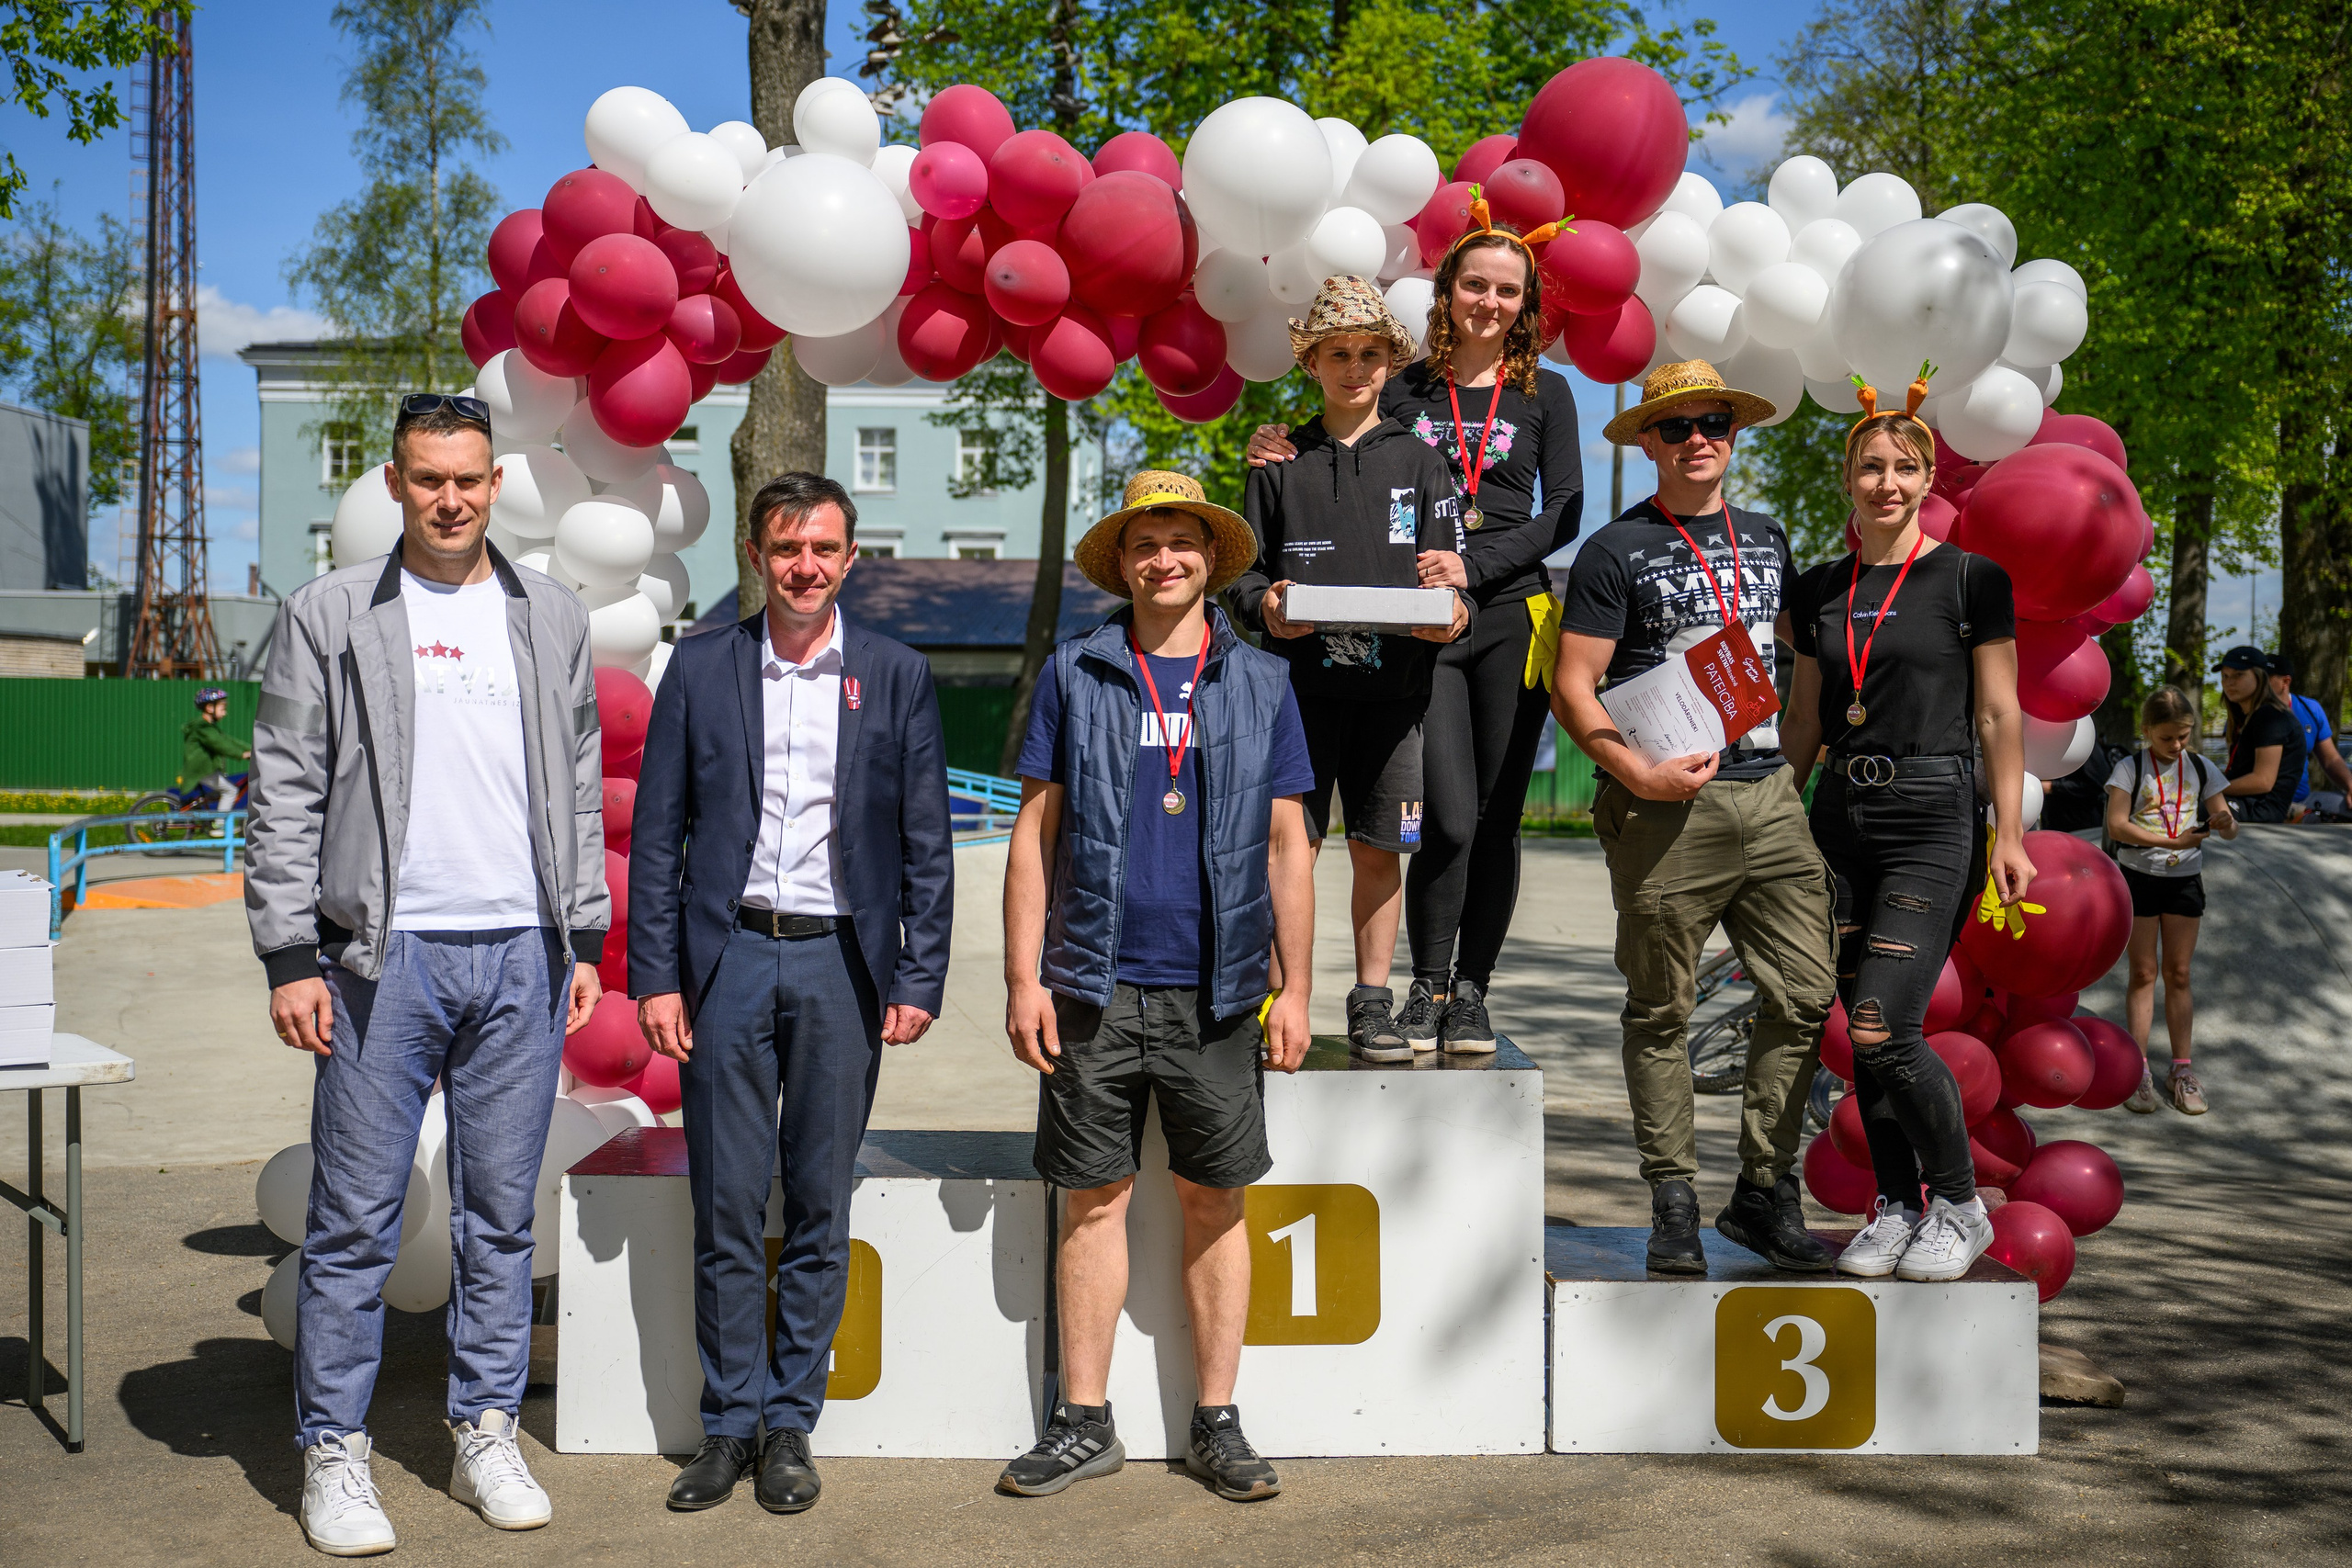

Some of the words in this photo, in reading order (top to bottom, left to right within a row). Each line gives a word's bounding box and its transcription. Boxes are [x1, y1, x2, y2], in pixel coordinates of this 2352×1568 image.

[1674, 691, 1699, 733] VELODĀRZNIEKI
[1704, 662, 1738, 721] PATEICĪBA
[1267, 1213, 1317, 1317] 1
[1761, 1314, 1831, 1422] 3
